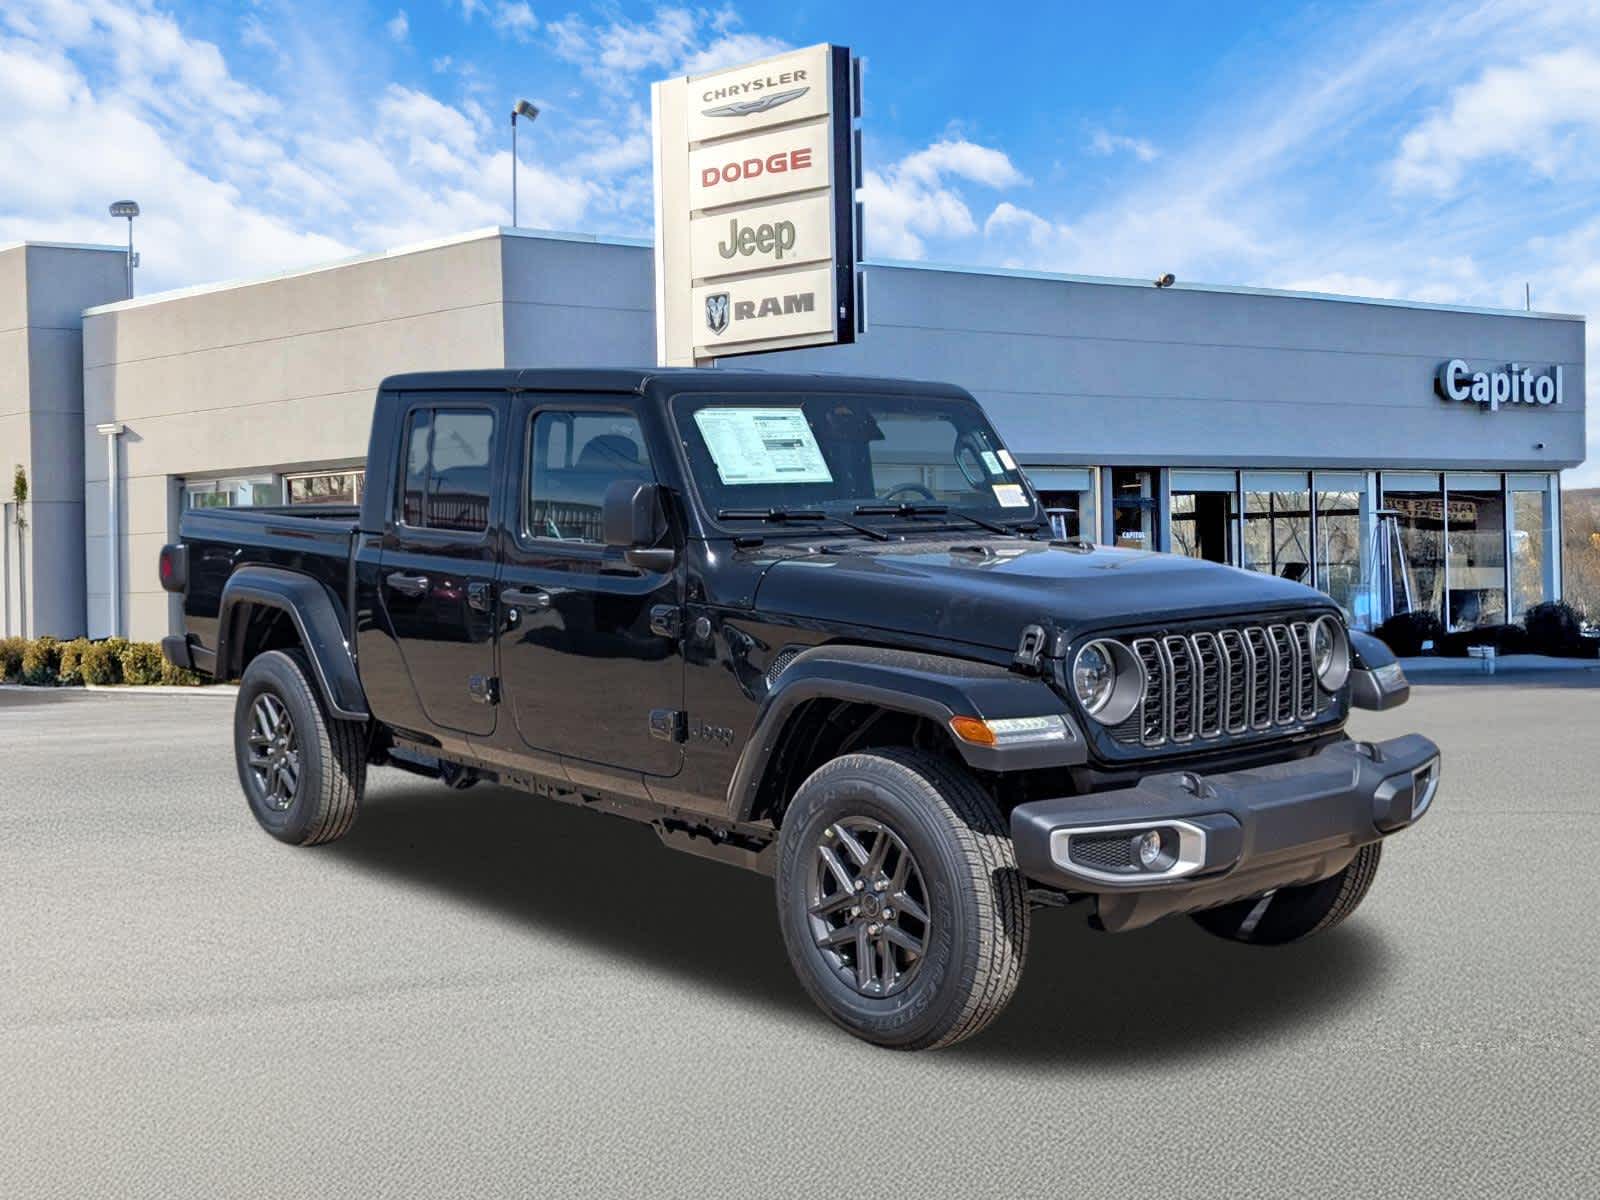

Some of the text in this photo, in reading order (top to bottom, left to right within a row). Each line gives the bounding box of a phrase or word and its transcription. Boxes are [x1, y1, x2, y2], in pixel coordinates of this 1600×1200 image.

[702, 70, 808, 102] CHRYSLER
[702, 148, 812, 188] DODGE
[718, 218, 796, 259] Jeep
[734, 292, 815, 321] RAM
[1446, 359, 1563, 411] Capitol
